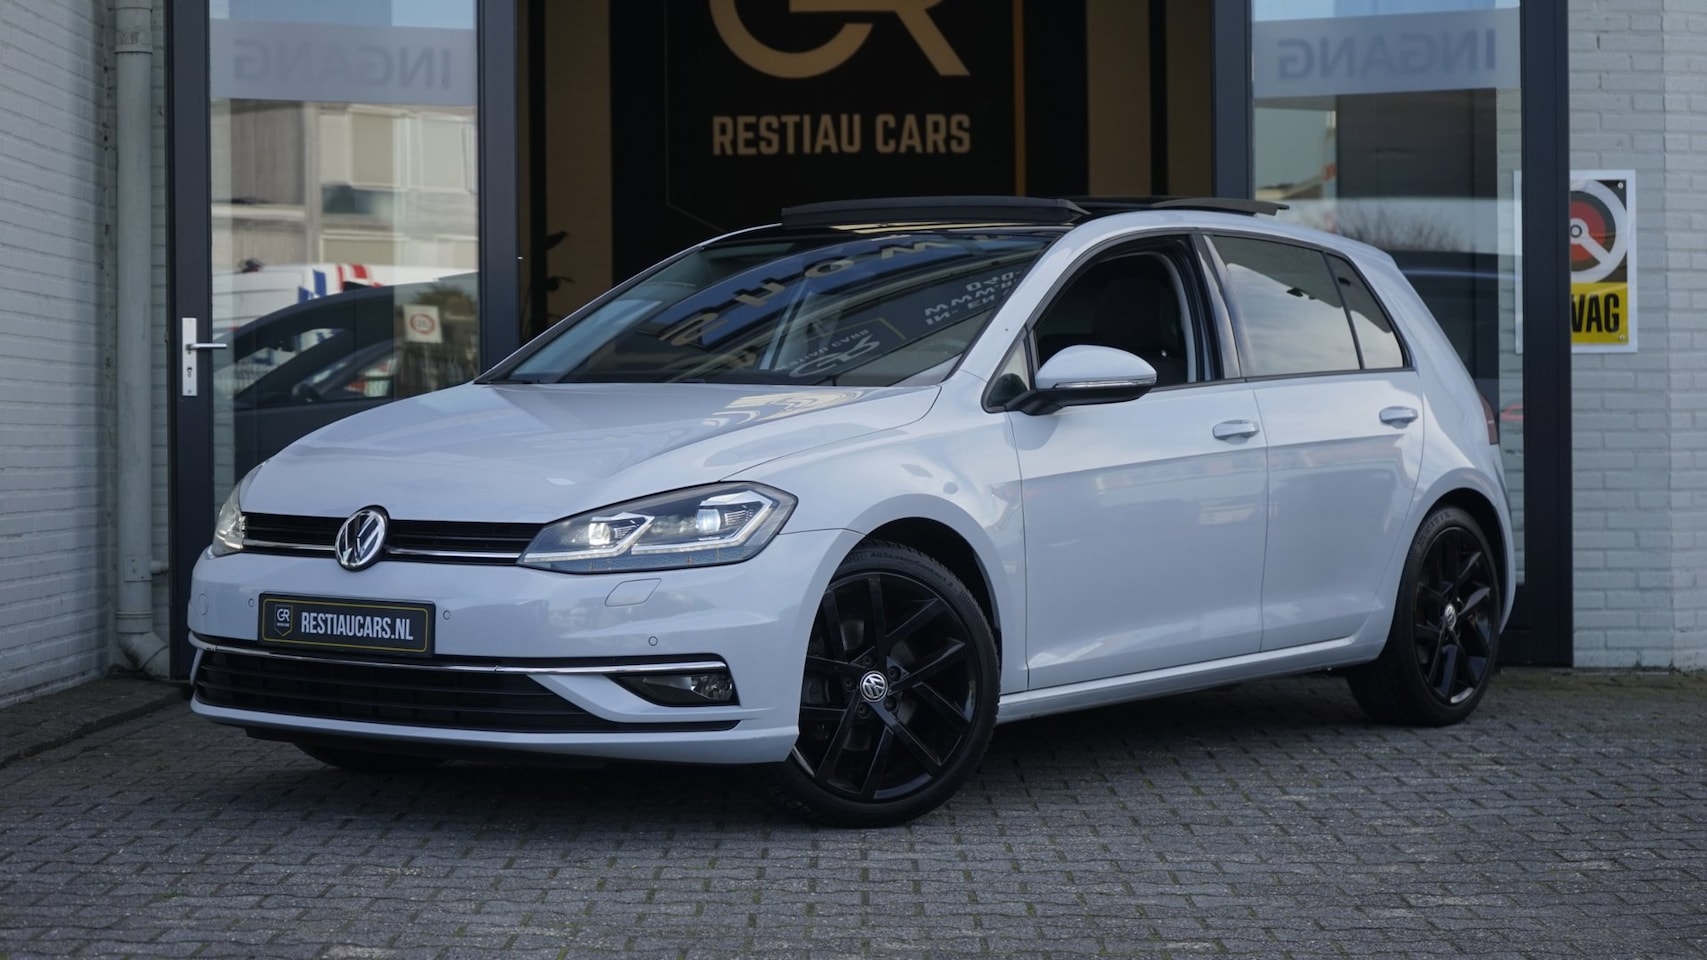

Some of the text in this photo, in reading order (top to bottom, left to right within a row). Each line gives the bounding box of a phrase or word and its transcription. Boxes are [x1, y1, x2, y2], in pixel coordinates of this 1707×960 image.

[712, 112, 971, 156] RESTIAU CARS
[300, 611, 414, 641] RESTIAUCARS.NL
